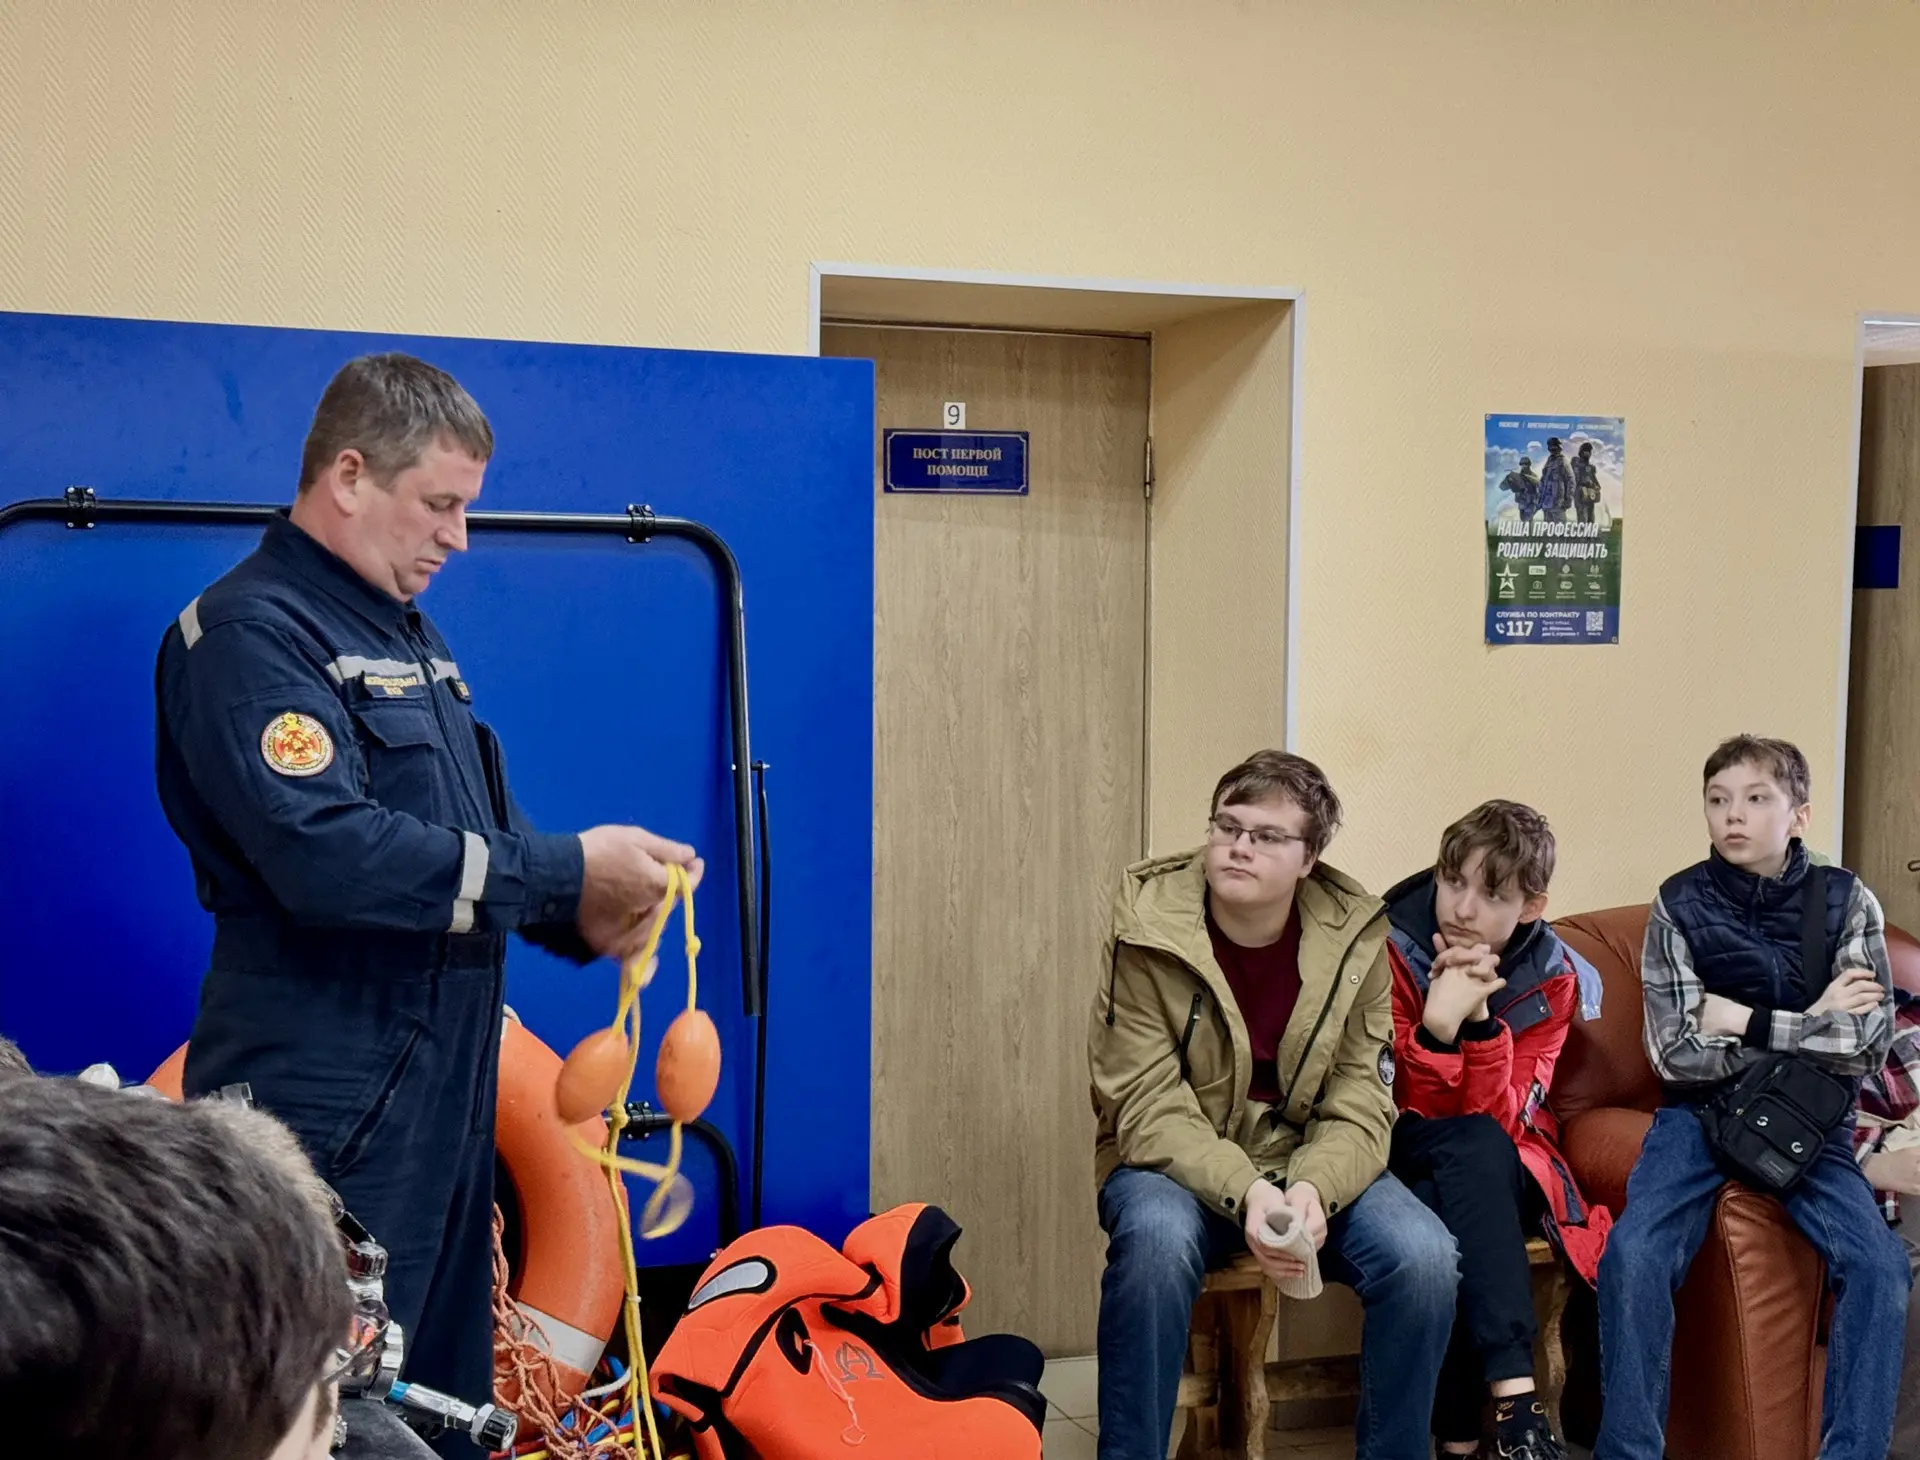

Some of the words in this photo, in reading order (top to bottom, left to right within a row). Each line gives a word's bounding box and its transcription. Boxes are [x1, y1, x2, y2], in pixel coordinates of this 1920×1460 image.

[948, 405, 960, 425] 9
[913, 448, 949, 460] ПОСТ
[951, 447, 1002, 461] ПЕРВОЙ
[927, 464, 989, 477] ПОМОЩИ
[1497, 521, 1530, 537] НАША
[1532, 522, 1599, 538] ПРОФЕССИЯ
[1496, 542, 1543, 559] РОДИНУ
[1544, 543, 1608, 560] ЗАЩИЩАТЬ
[1539, 611, 1580, 619] КОНТРАКТУ
[1506, 620, 1534, 636] 117
